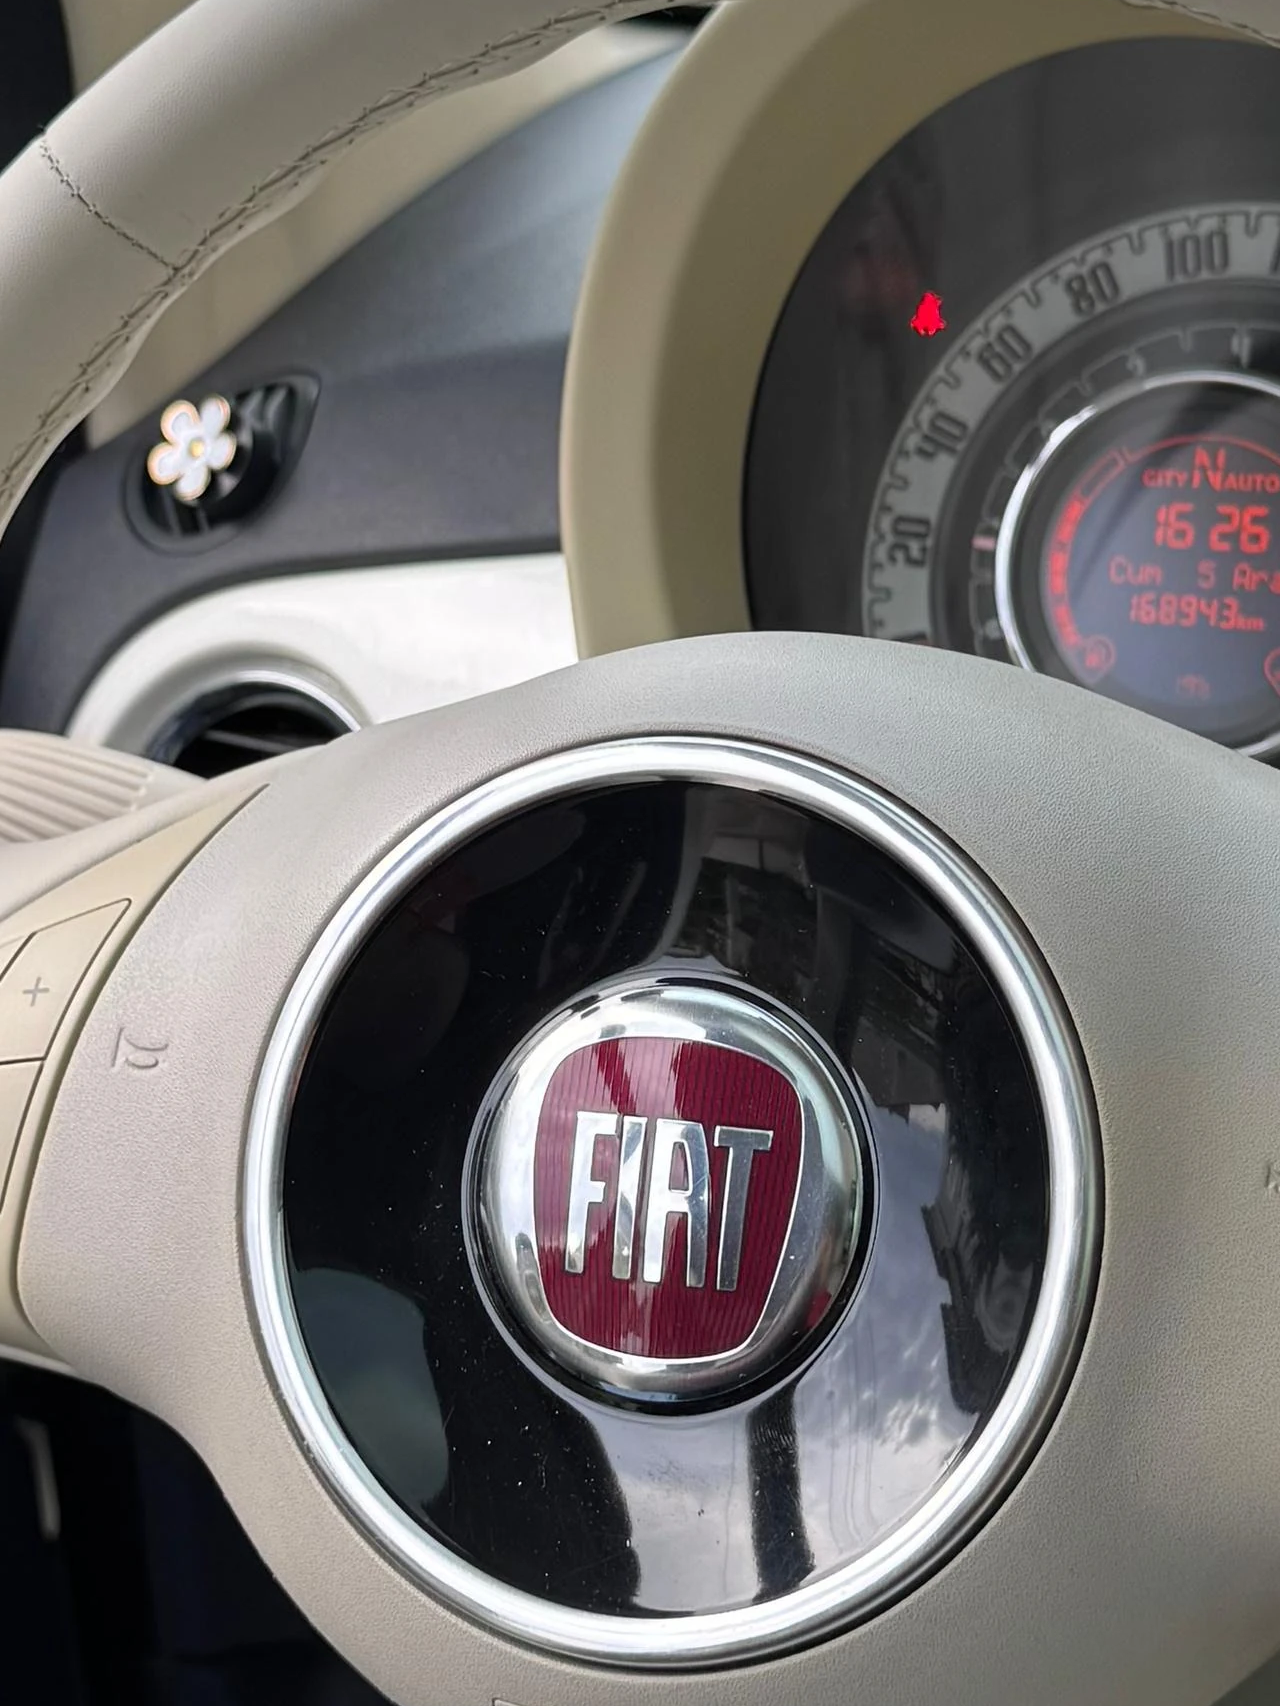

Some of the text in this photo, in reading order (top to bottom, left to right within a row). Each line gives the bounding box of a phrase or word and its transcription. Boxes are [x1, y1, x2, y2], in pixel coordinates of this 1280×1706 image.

[1163, 229, 1229, 283] 100
[1064, 261, 1120, 317] 80
[977, 324, 1033, 384] 60
[916, 410, 968, 462] 40
[1142, 468, 1188, 488] CITY
[1192, 446, 1227, 491] N
[888, 515, 931, 569] 20
[565, 1110, 774, 1292] FIAT
